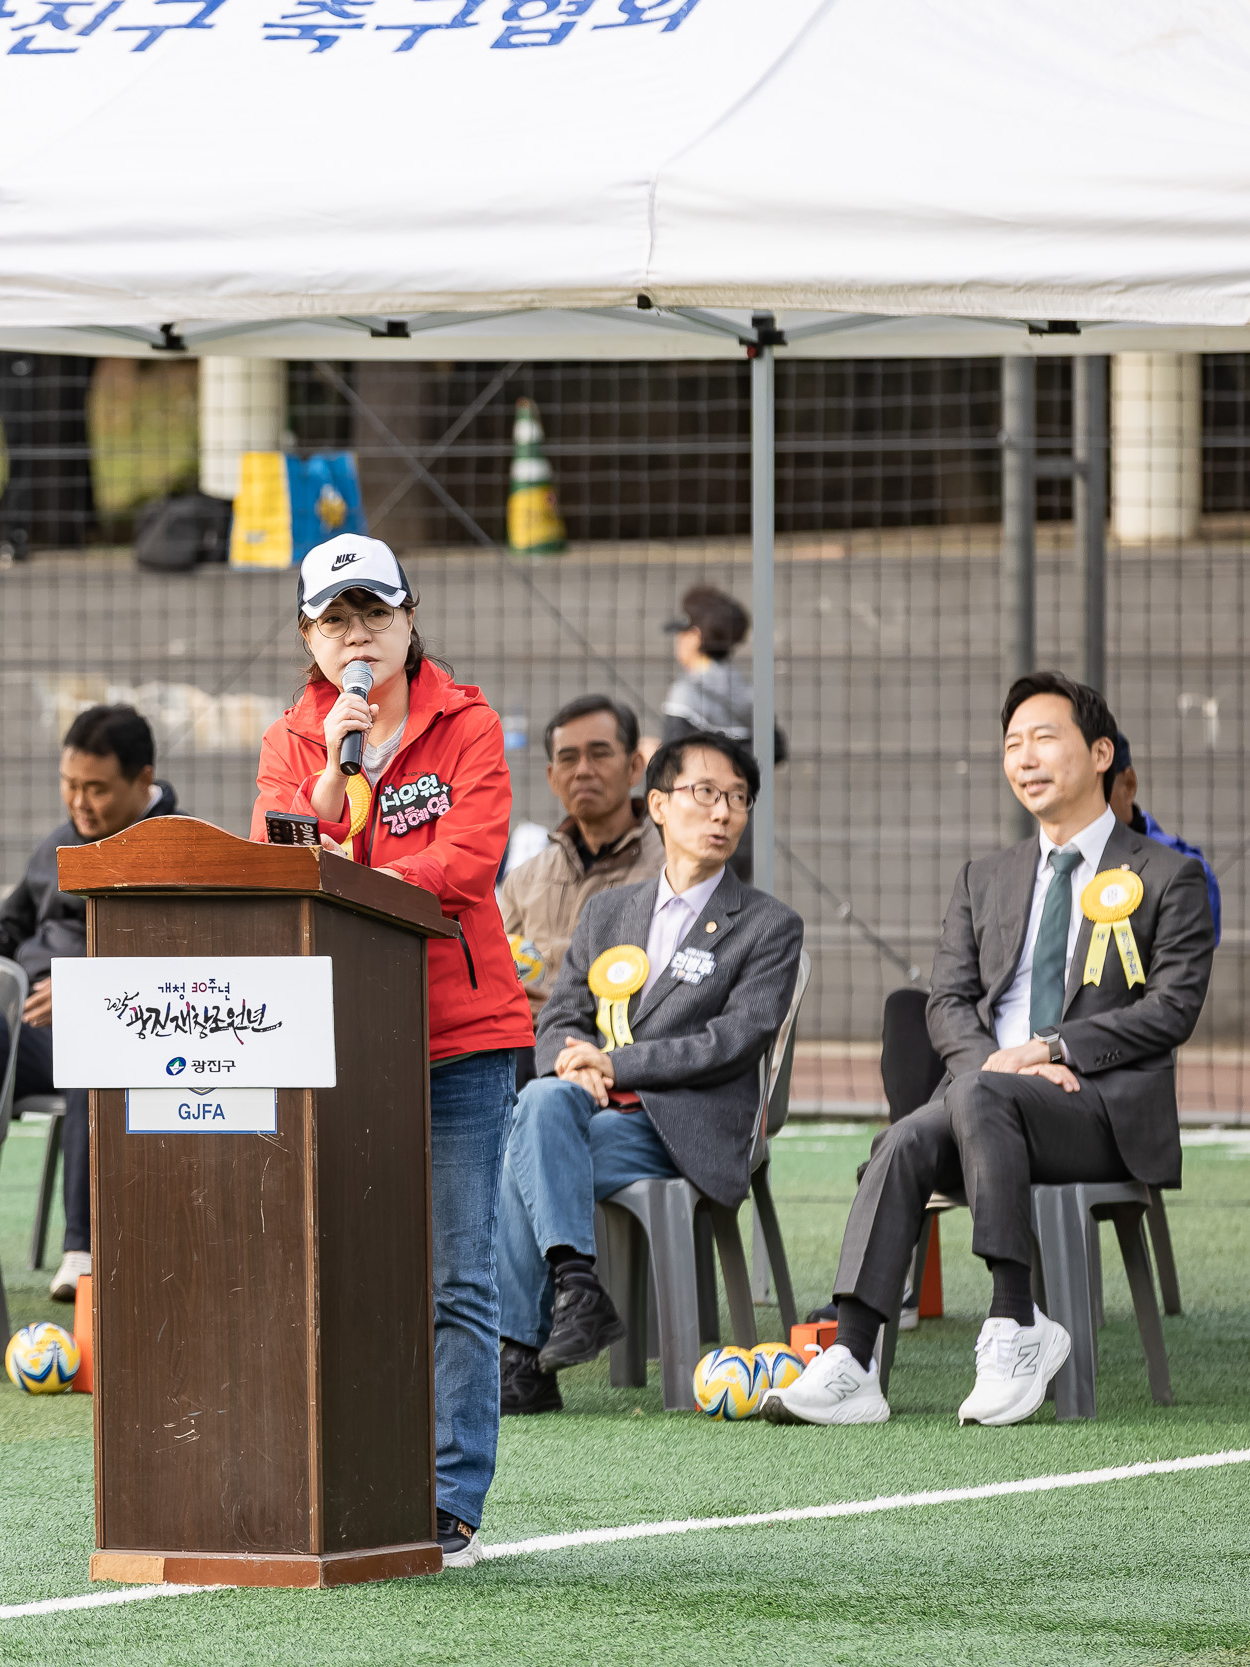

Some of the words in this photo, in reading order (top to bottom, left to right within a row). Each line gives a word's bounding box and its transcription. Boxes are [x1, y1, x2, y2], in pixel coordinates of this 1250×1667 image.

[335, 553, 357, 564] NIKE
[381, 774, 440, 812] 시의원
[382, 793, 450, 834] 김혜영
[157, 982, 185, 1000] 개청
[191, 978, 230, 1001] 30주년
[190, 1059, 237, 1074] 광진구
[177, 1103, 226, 1121] GJFA
